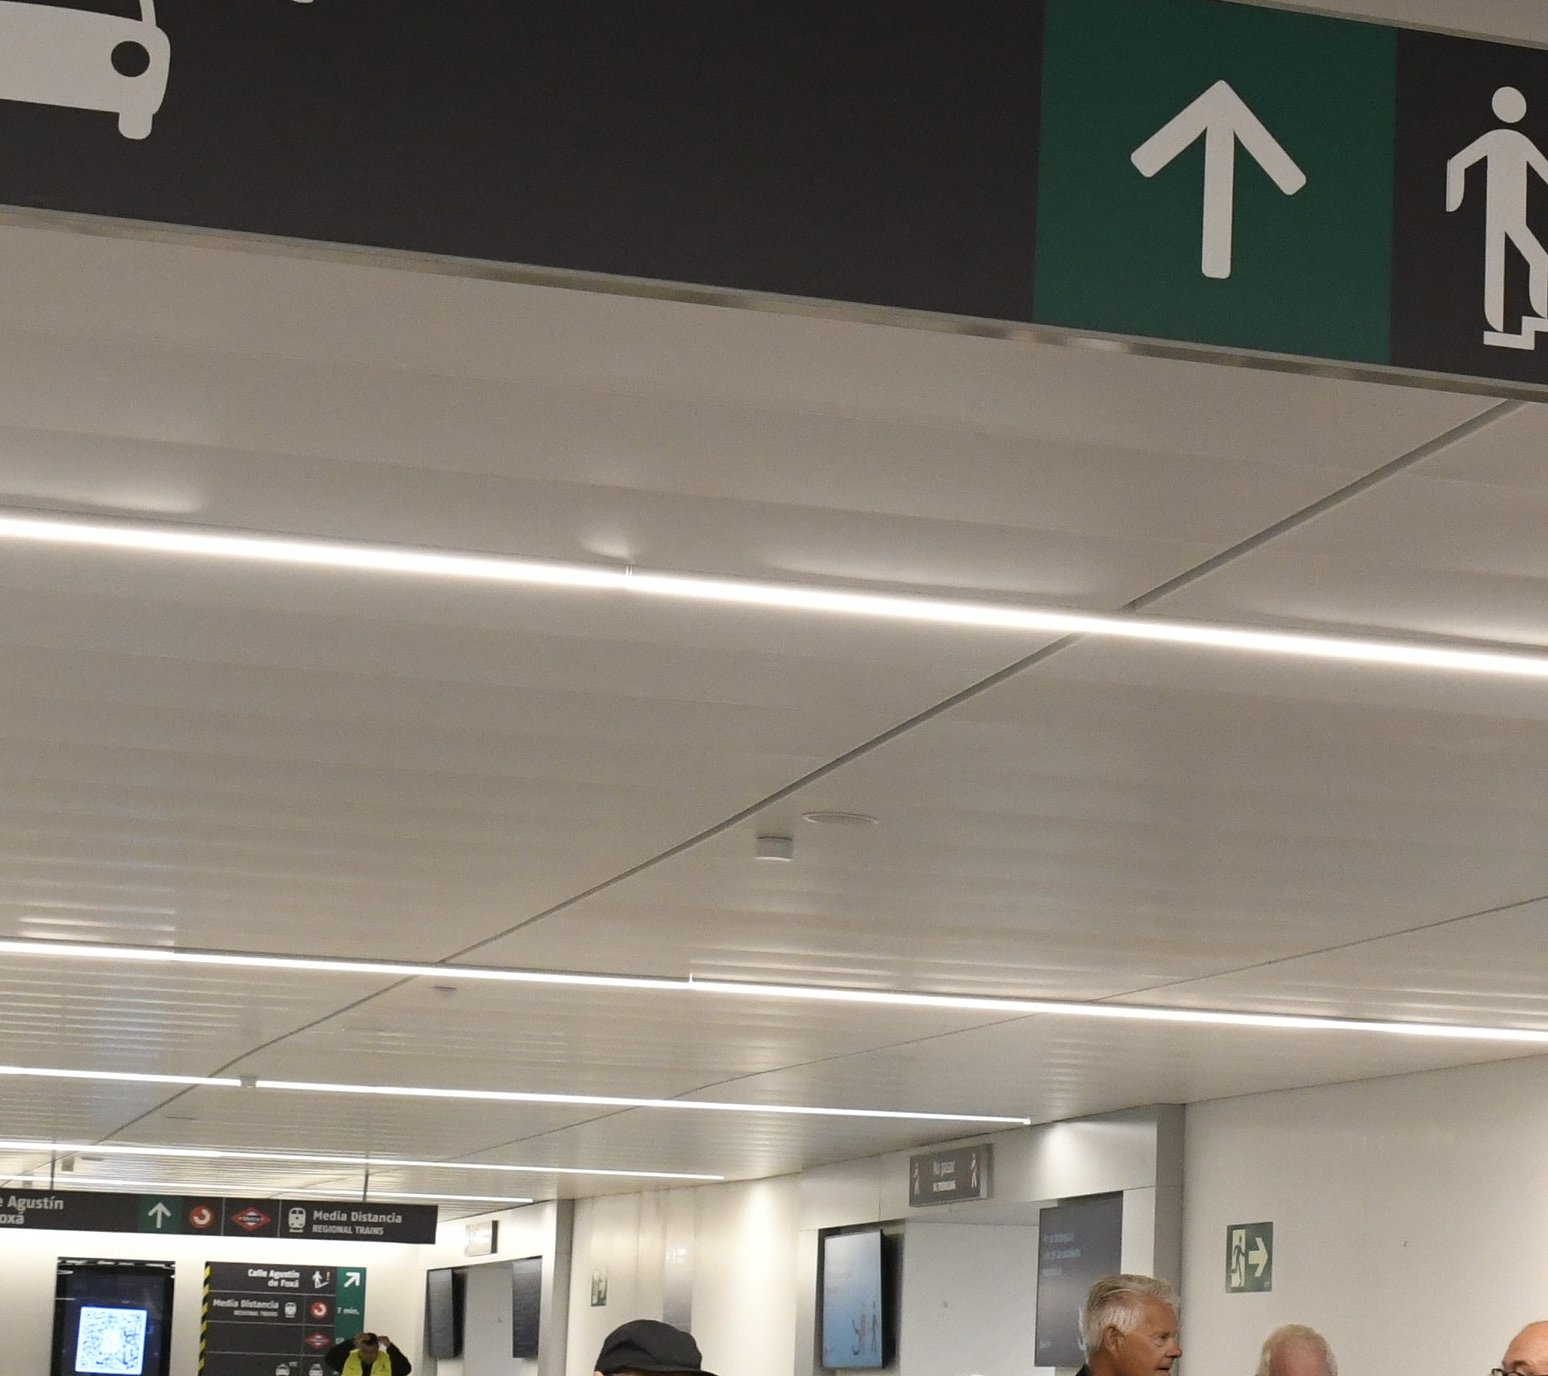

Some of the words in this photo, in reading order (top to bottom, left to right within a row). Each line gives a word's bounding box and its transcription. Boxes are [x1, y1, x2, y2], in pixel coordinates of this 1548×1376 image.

[7, 1195, 64, 1212] Agustín
[312, 1210, 348, 1222] Media
[351, 1211, 402, 1224] Distancia
[268, 1279, 279, 1287] de
